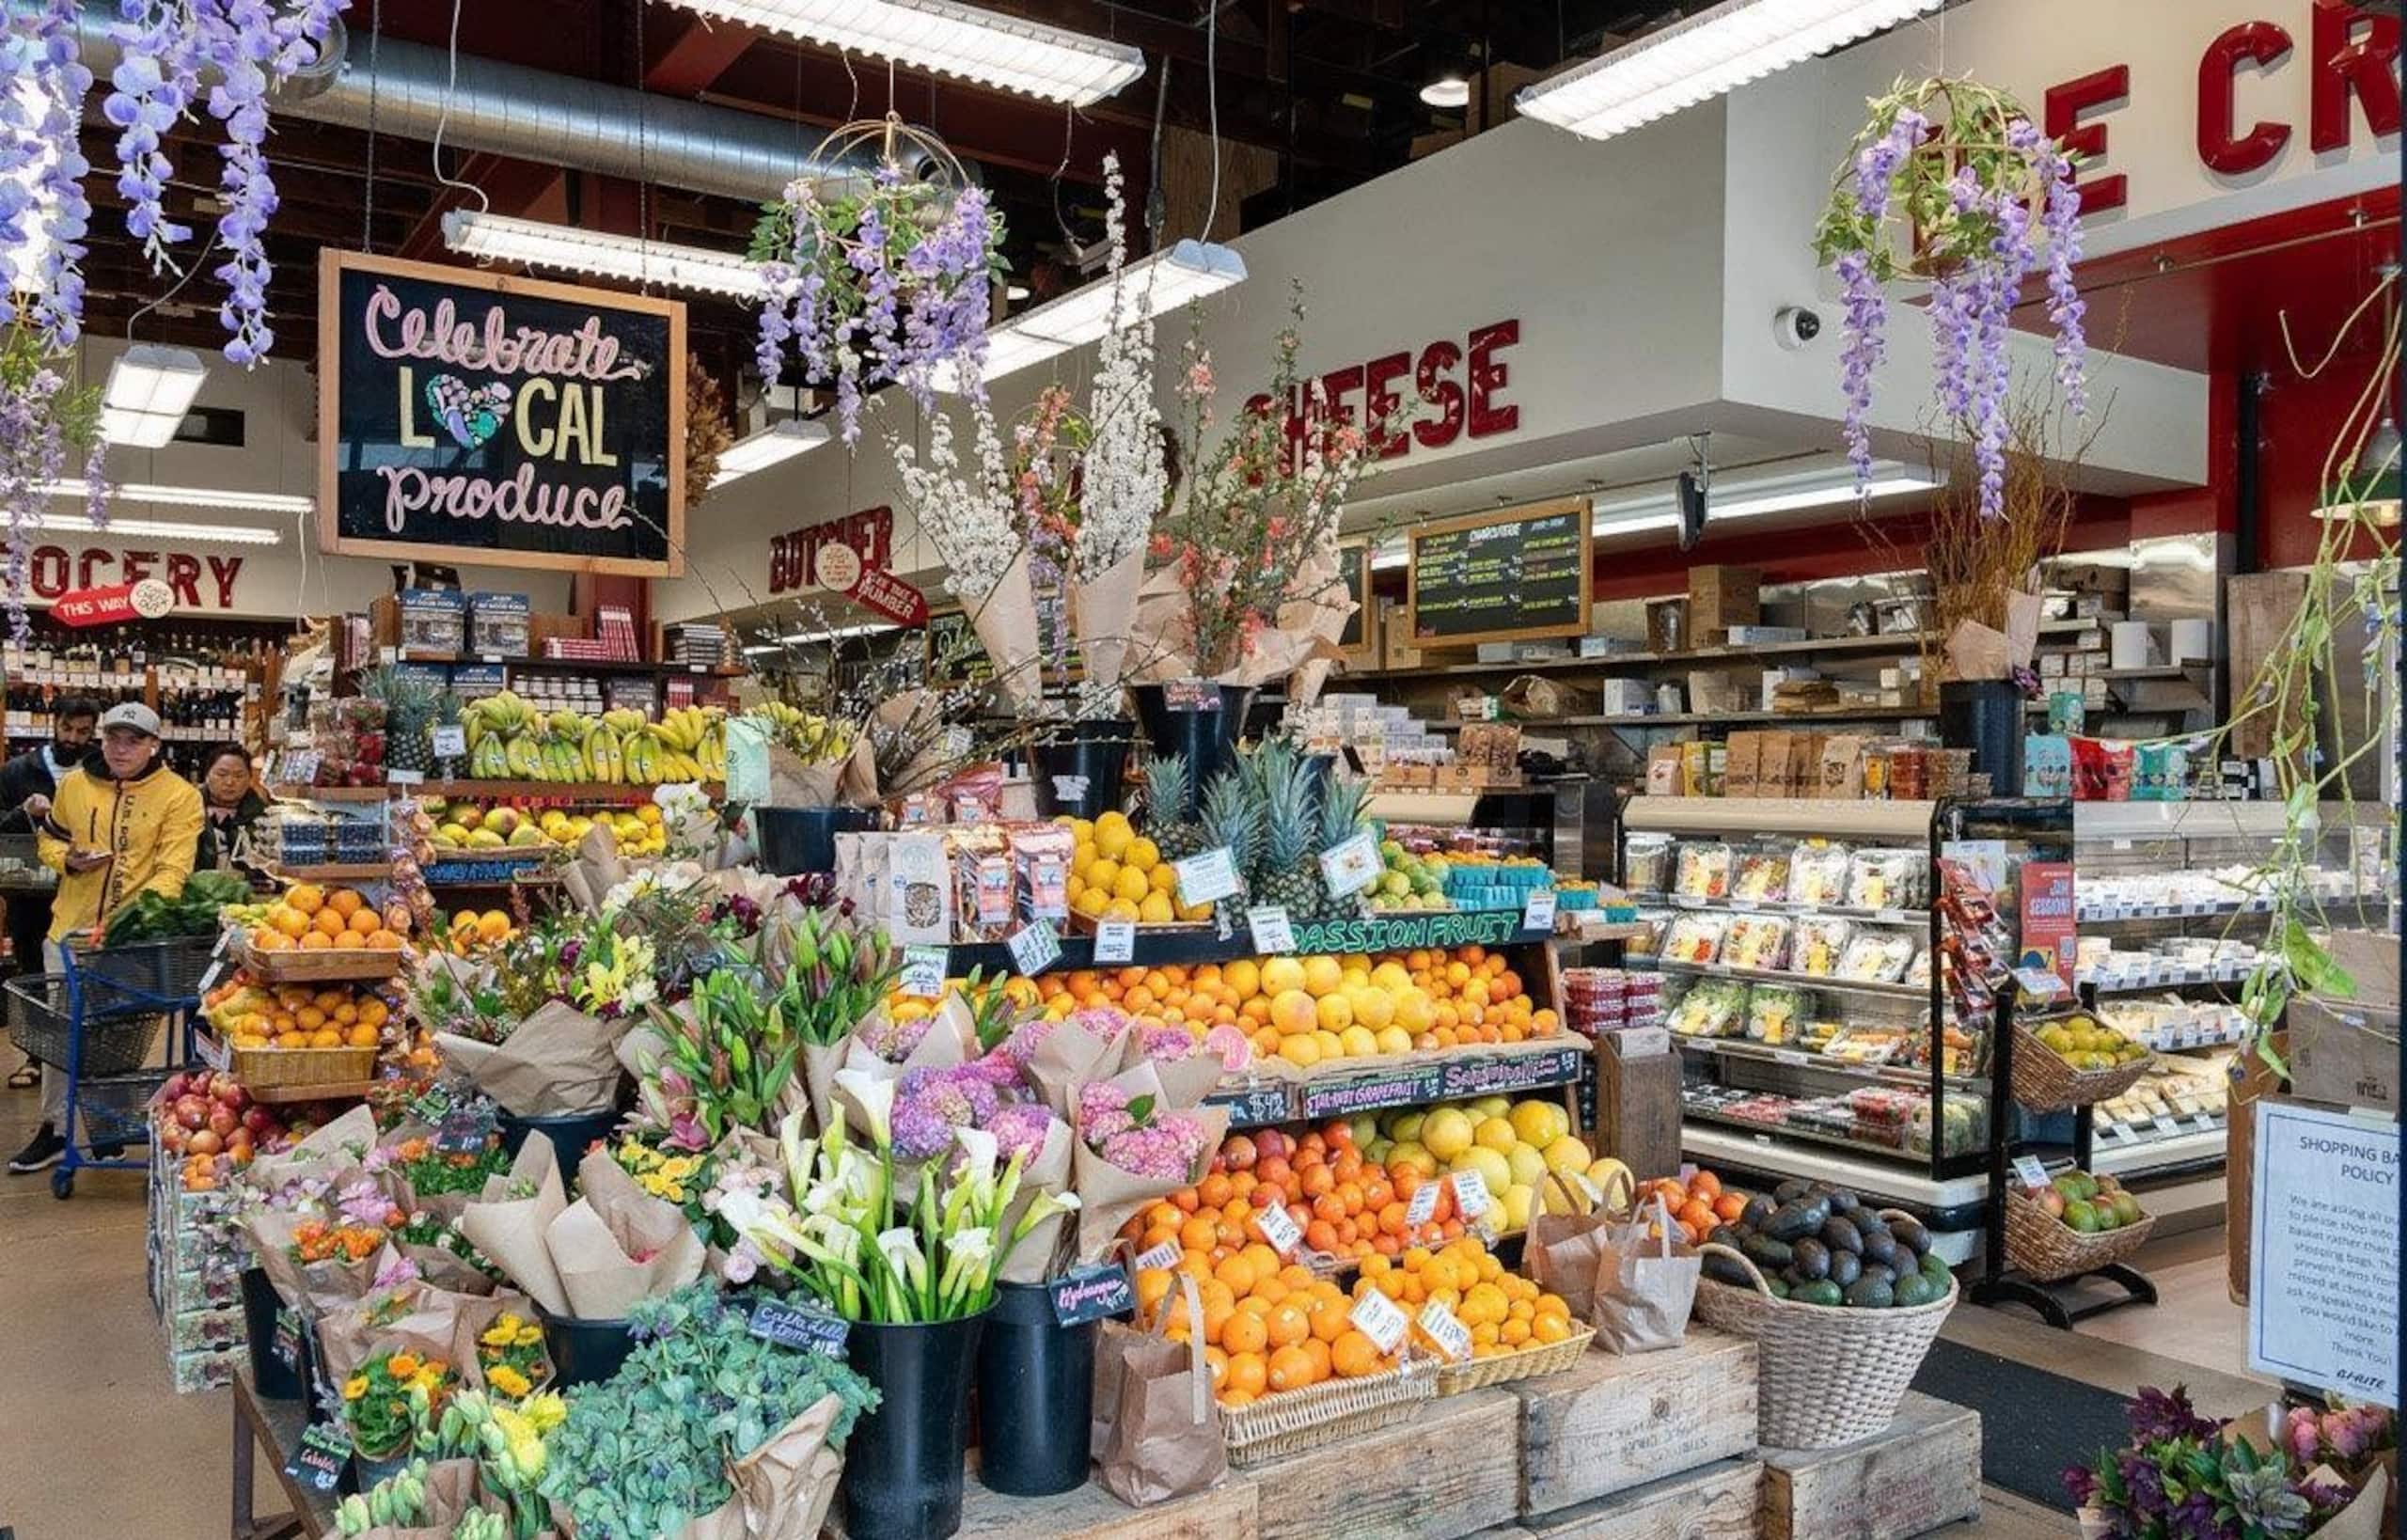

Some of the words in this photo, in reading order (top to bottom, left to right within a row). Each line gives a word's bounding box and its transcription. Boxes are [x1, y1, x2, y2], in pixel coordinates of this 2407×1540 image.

[366, 285, 653, 381] Celebrate
[399, 368, 619, 467] LCAL
[376, 463, 634, 533] produce
[769, 505, 893, 593] BUTHER
[0, 542, 244, 608] OCERY
[60, 601, 93, 618] THIS
[97, 595, 129, 613] WAY
[857, 578, 915, 620] NUMBER
[1289, 918, 1429, 953] PASSION
[1431, 911, 1520, 946] FRUIT
[2300, 1136, 2377, 1162] SHOPPING
[2341, 1165, 2395, 1186] POLICY
[2289, 1194, 2306, 1204] We
[2341, 1221, 2368, 1235] shop
[761, 1307, 806, 1329] Calla
[2331, 1342, 2364, 1359] Thank
[2336, 1368, 2387, 1390] BI-RITE
